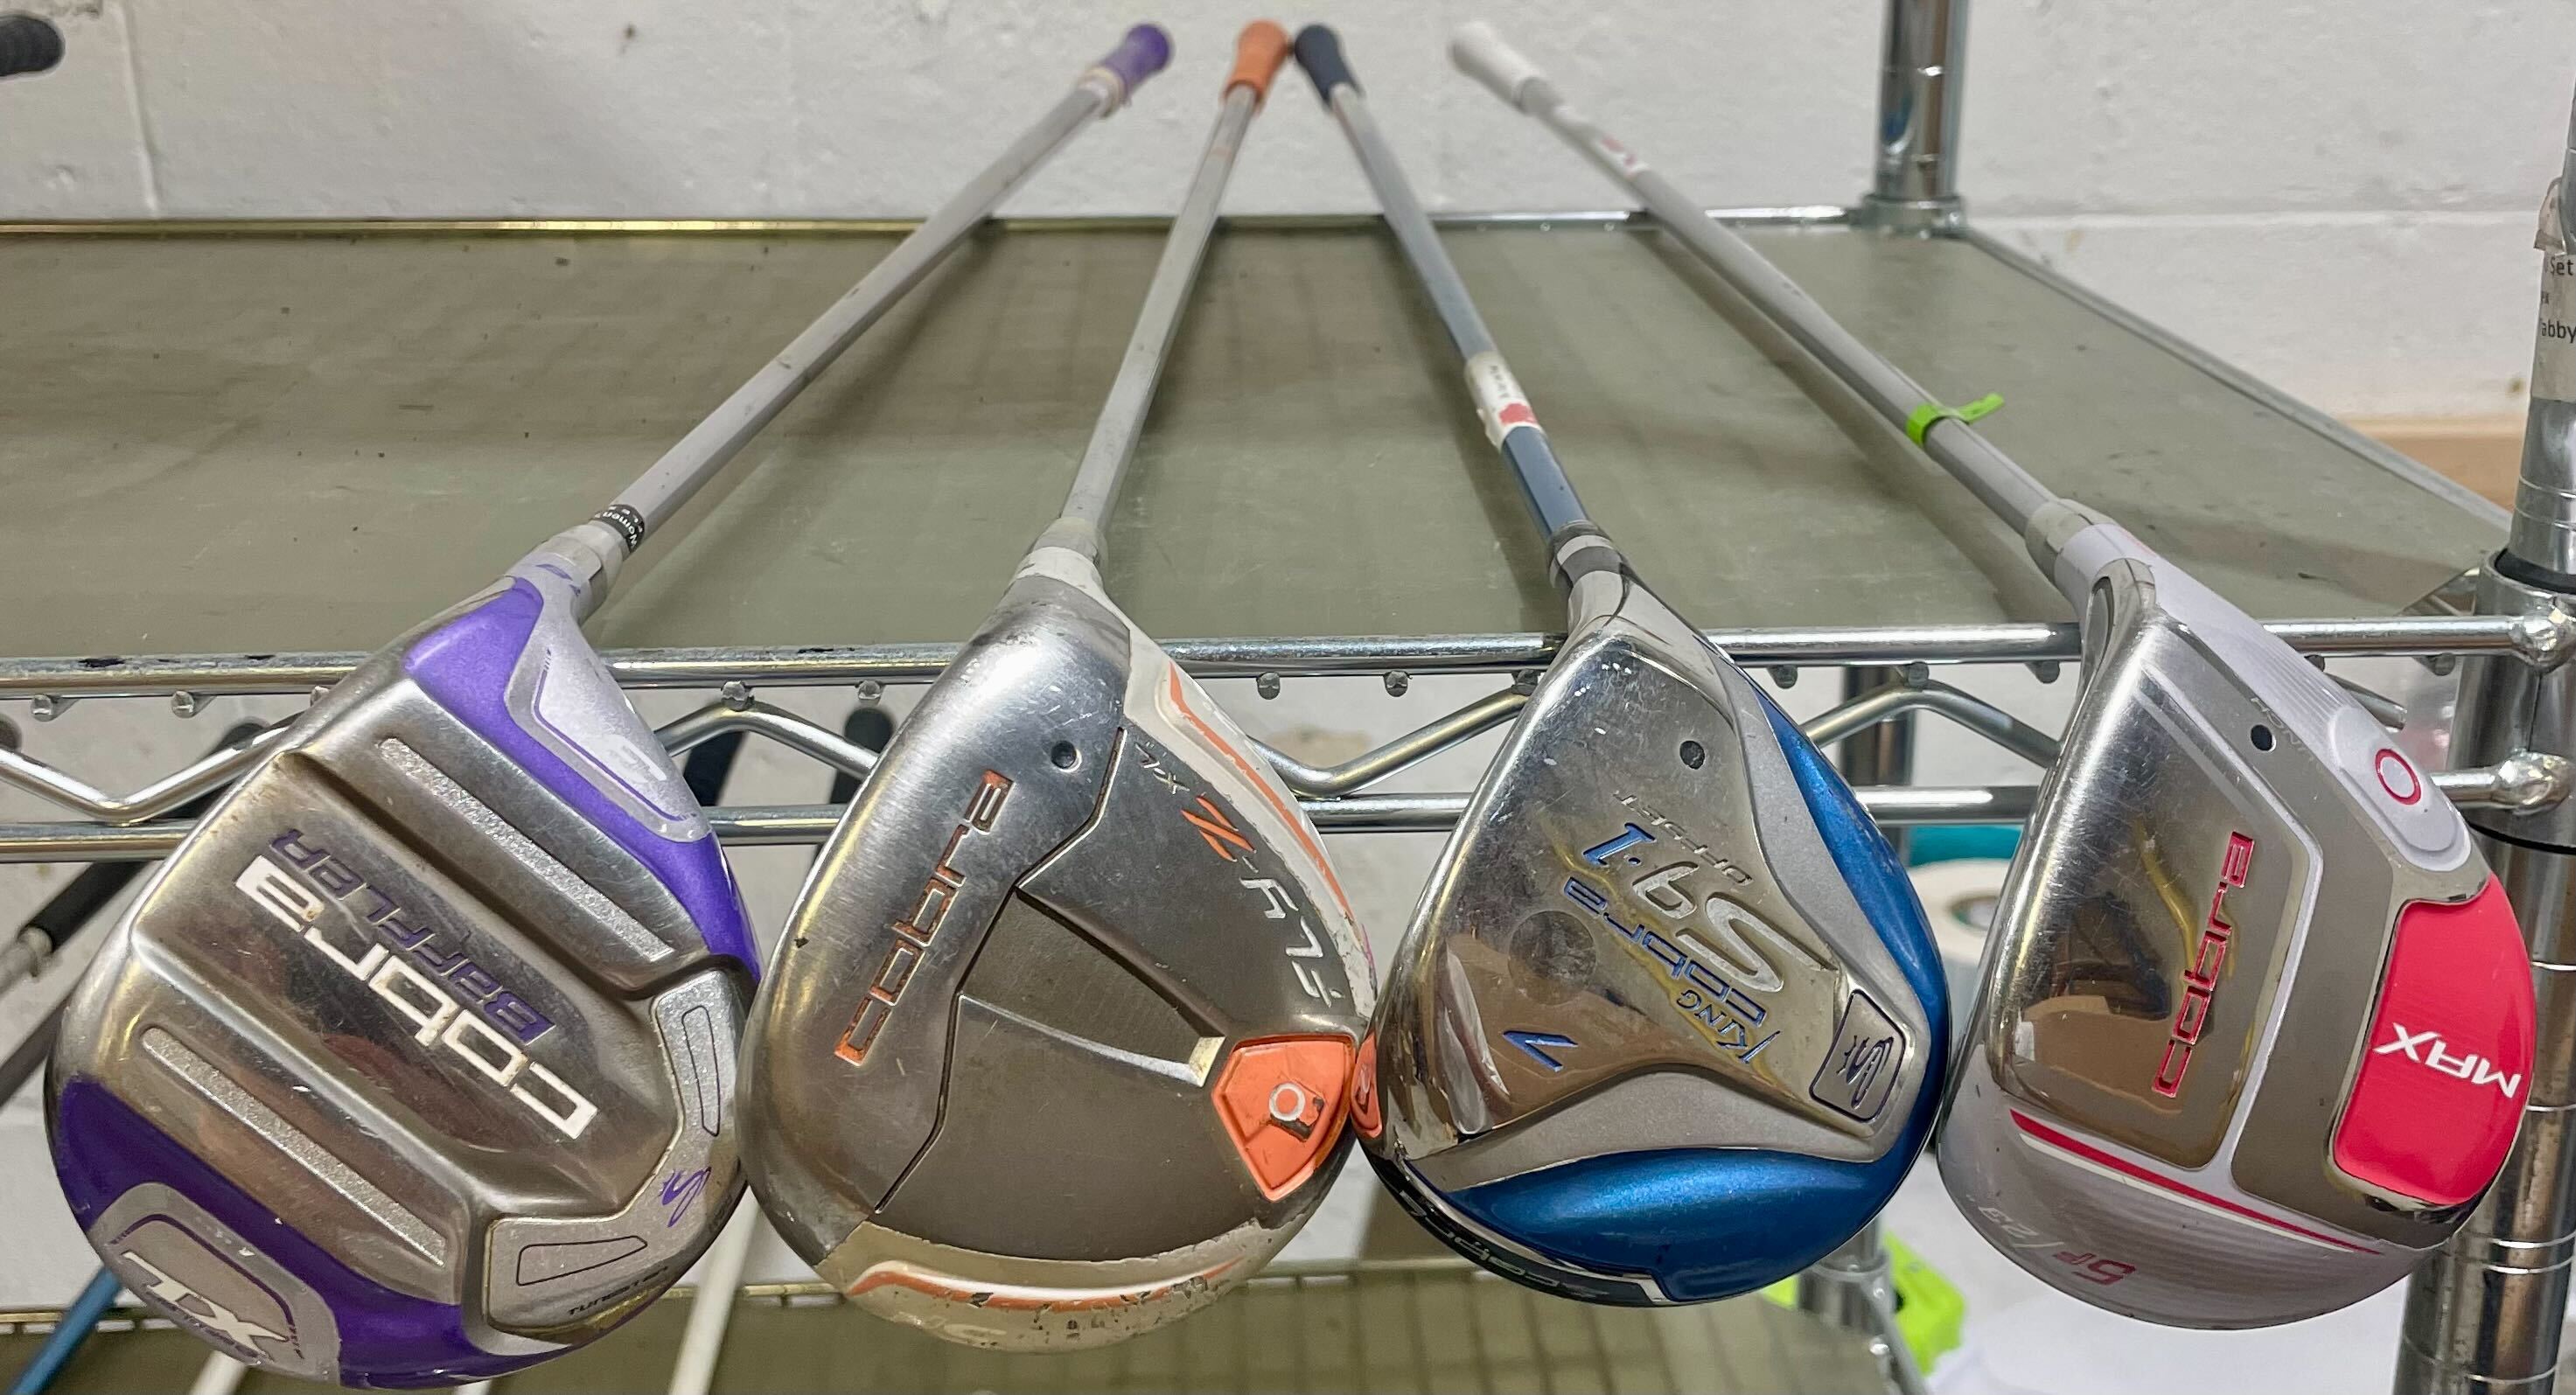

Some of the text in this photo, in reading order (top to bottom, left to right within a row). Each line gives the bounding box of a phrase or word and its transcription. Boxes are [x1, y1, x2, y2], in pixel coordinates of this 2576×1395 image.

[2540, 318, 2576, 344] abby
[1612, 792, 1754, 886] OFFSET
[834, 769, 1016, 1067] cobra
[1562, 876, 1767, 1029] cobra
[2152, 831, 2254, 1098] cobra
[235, 855, 599, 1140] cobra
[2373, 1022, 2523, 1099] MAX
